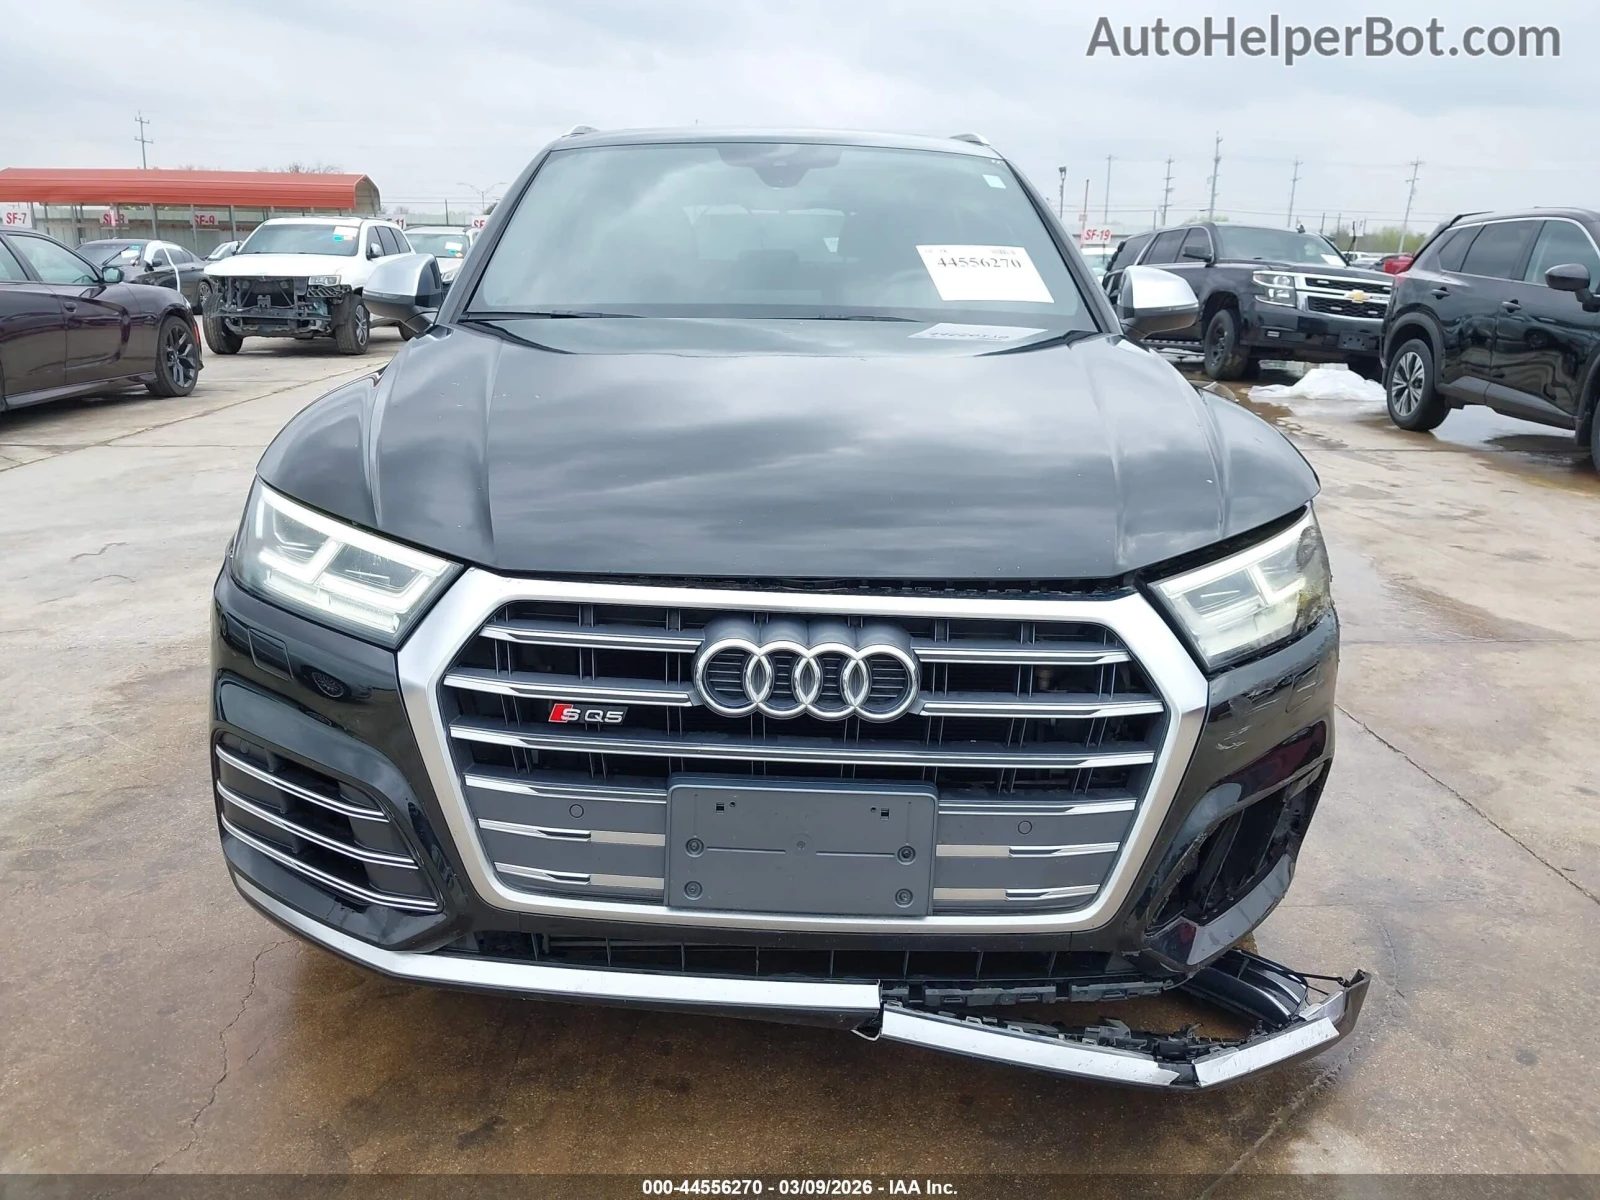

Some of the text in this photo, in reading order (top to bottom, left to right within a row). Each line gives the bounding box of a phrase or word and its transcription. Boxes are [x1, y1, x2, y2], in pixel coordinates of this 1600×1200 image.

[6, 212, 27, 225] SF-7
[1084, 229, 1111, 241] SF-19
[937, 257, 1022, 269] 44556270
[560, 708, 624, 723] SQ5
